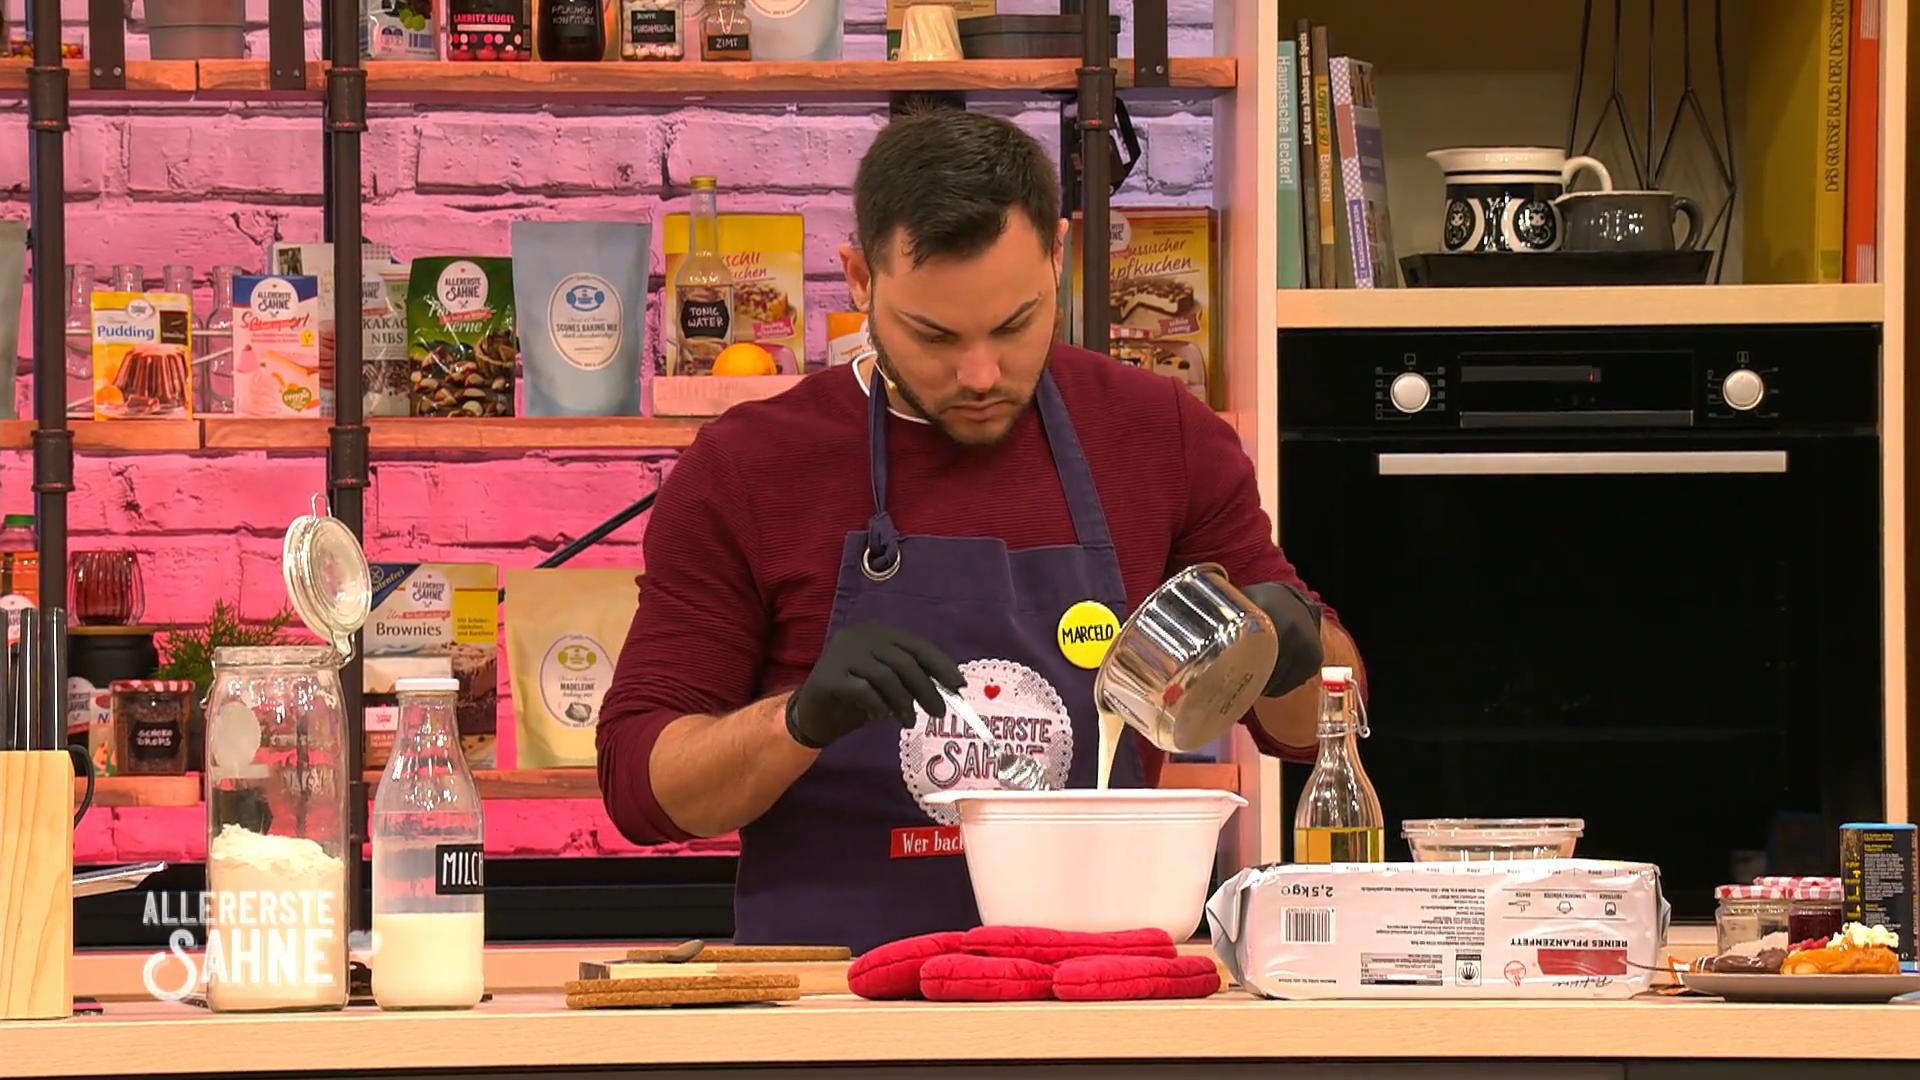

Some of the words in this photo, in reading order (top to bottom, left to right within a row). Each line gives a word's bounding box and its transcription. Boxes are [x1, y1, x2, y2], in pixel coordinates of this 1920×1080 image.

[716, 38, 738, 49] ZIMT
[1277, 55, 1294, 134] Hauptsache
[1279, 137, 1294, 185] lecker!
[1824, 168, 1839, 192] DAS
[1110, 255, 1192, 280] upfkuchen
[445, 286, 480, 302] SAHNE
[258, 299, 290, 312] SAHNE
[689, 306, 720, 318] TONIC
[582, 323, 606, 333] BAKING
[687, 316, 724, 329] WATER
[97, 325, 155, 341] Pudding
[371, 332, 404, 344] NIBS
[412, 589, 443, 602] SAHNE
[376, 622, 442, 637] Brownies
[1061, 624, 1114, 647] MARCELO
[560, 682, 594, 691] MADELEINE
[902, 832, 929, 855] Wer
[1510, 938, 1589, 948] PFLANZENFETT
[1591, 939, 1628, 948] REINES
